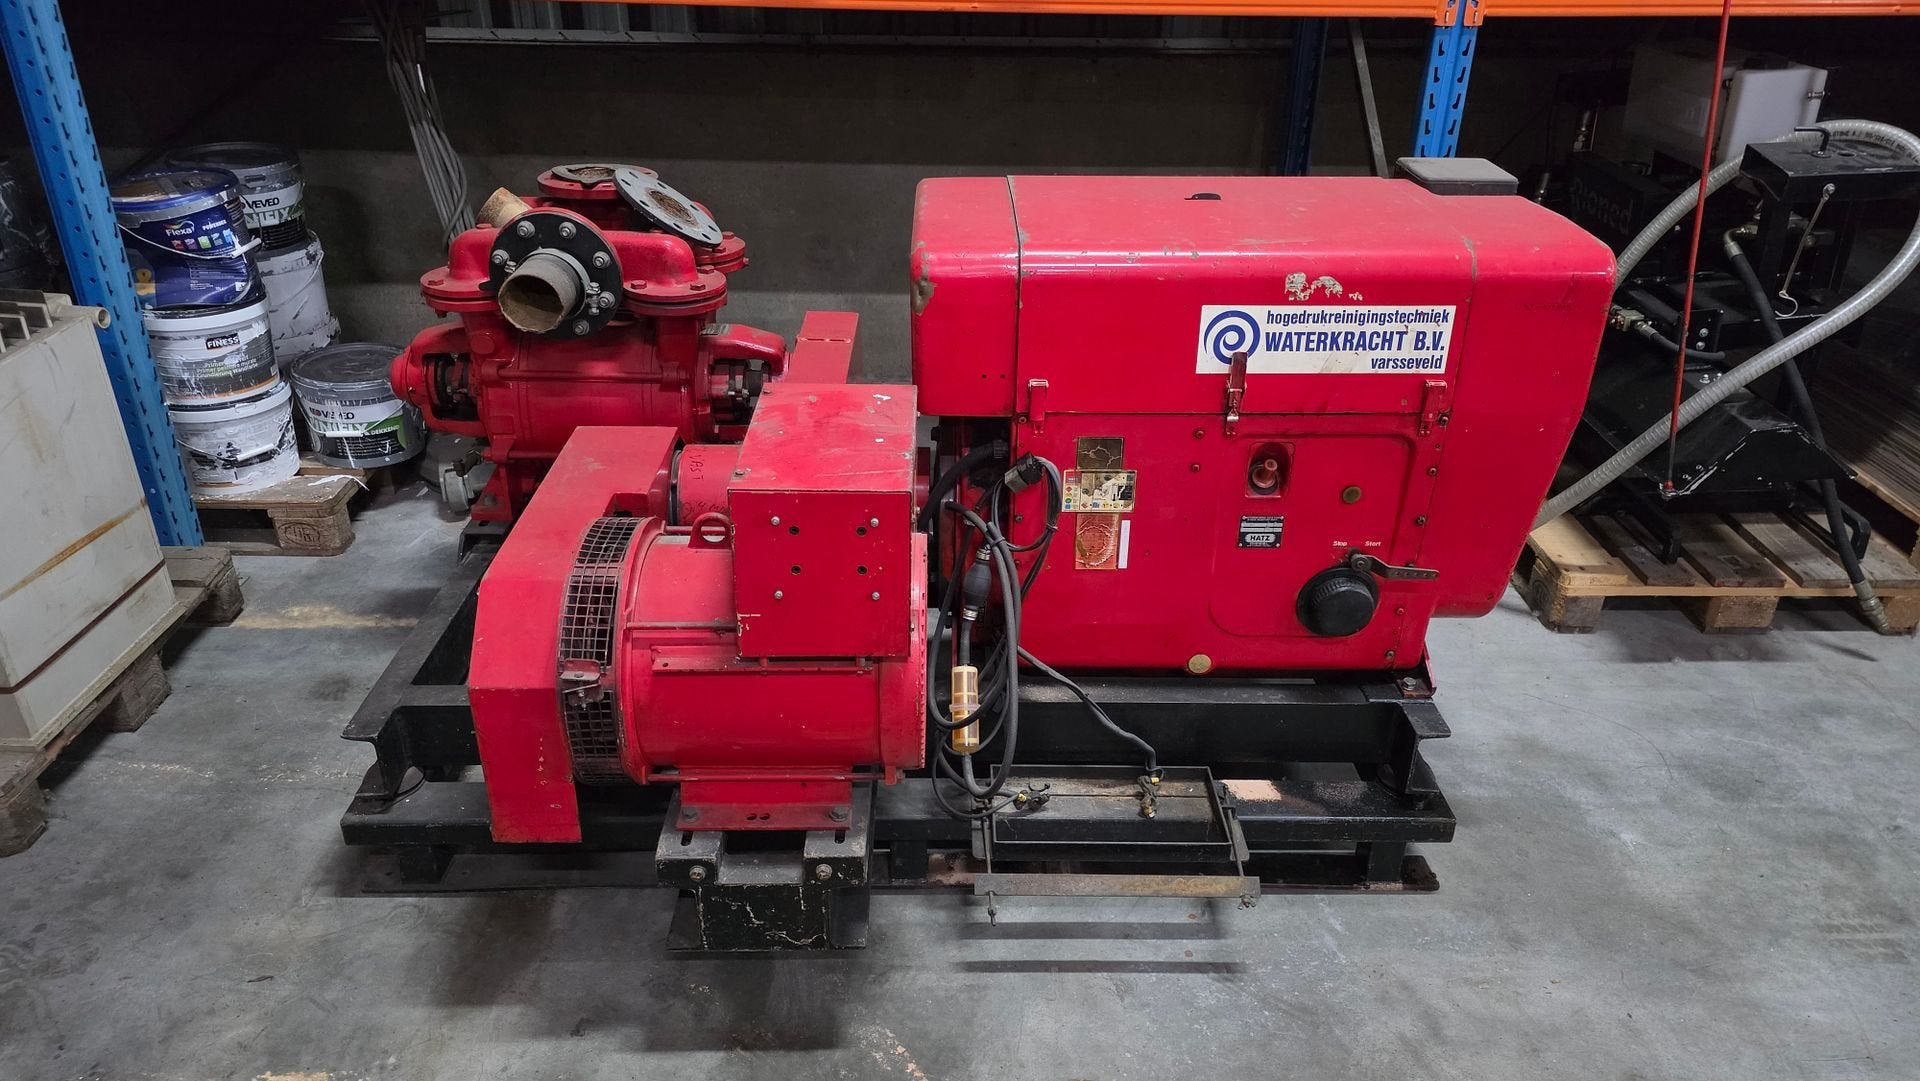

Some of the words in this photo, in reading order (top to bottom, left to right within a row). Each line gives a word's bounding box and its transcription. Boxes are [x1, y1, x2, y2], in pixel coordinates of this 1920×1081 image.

[165, 227, 193, 237] Flexa
[1266, 309, 1450, 327] hogedrukreinigingstechniek
[207, 336, 239, 349] FINESS
[1265, 330, 1408, 352] WATERKRACHT
[1413, 330, 1445, 351] B.V.
[1371, 354, 1444, 370] varsseveld
